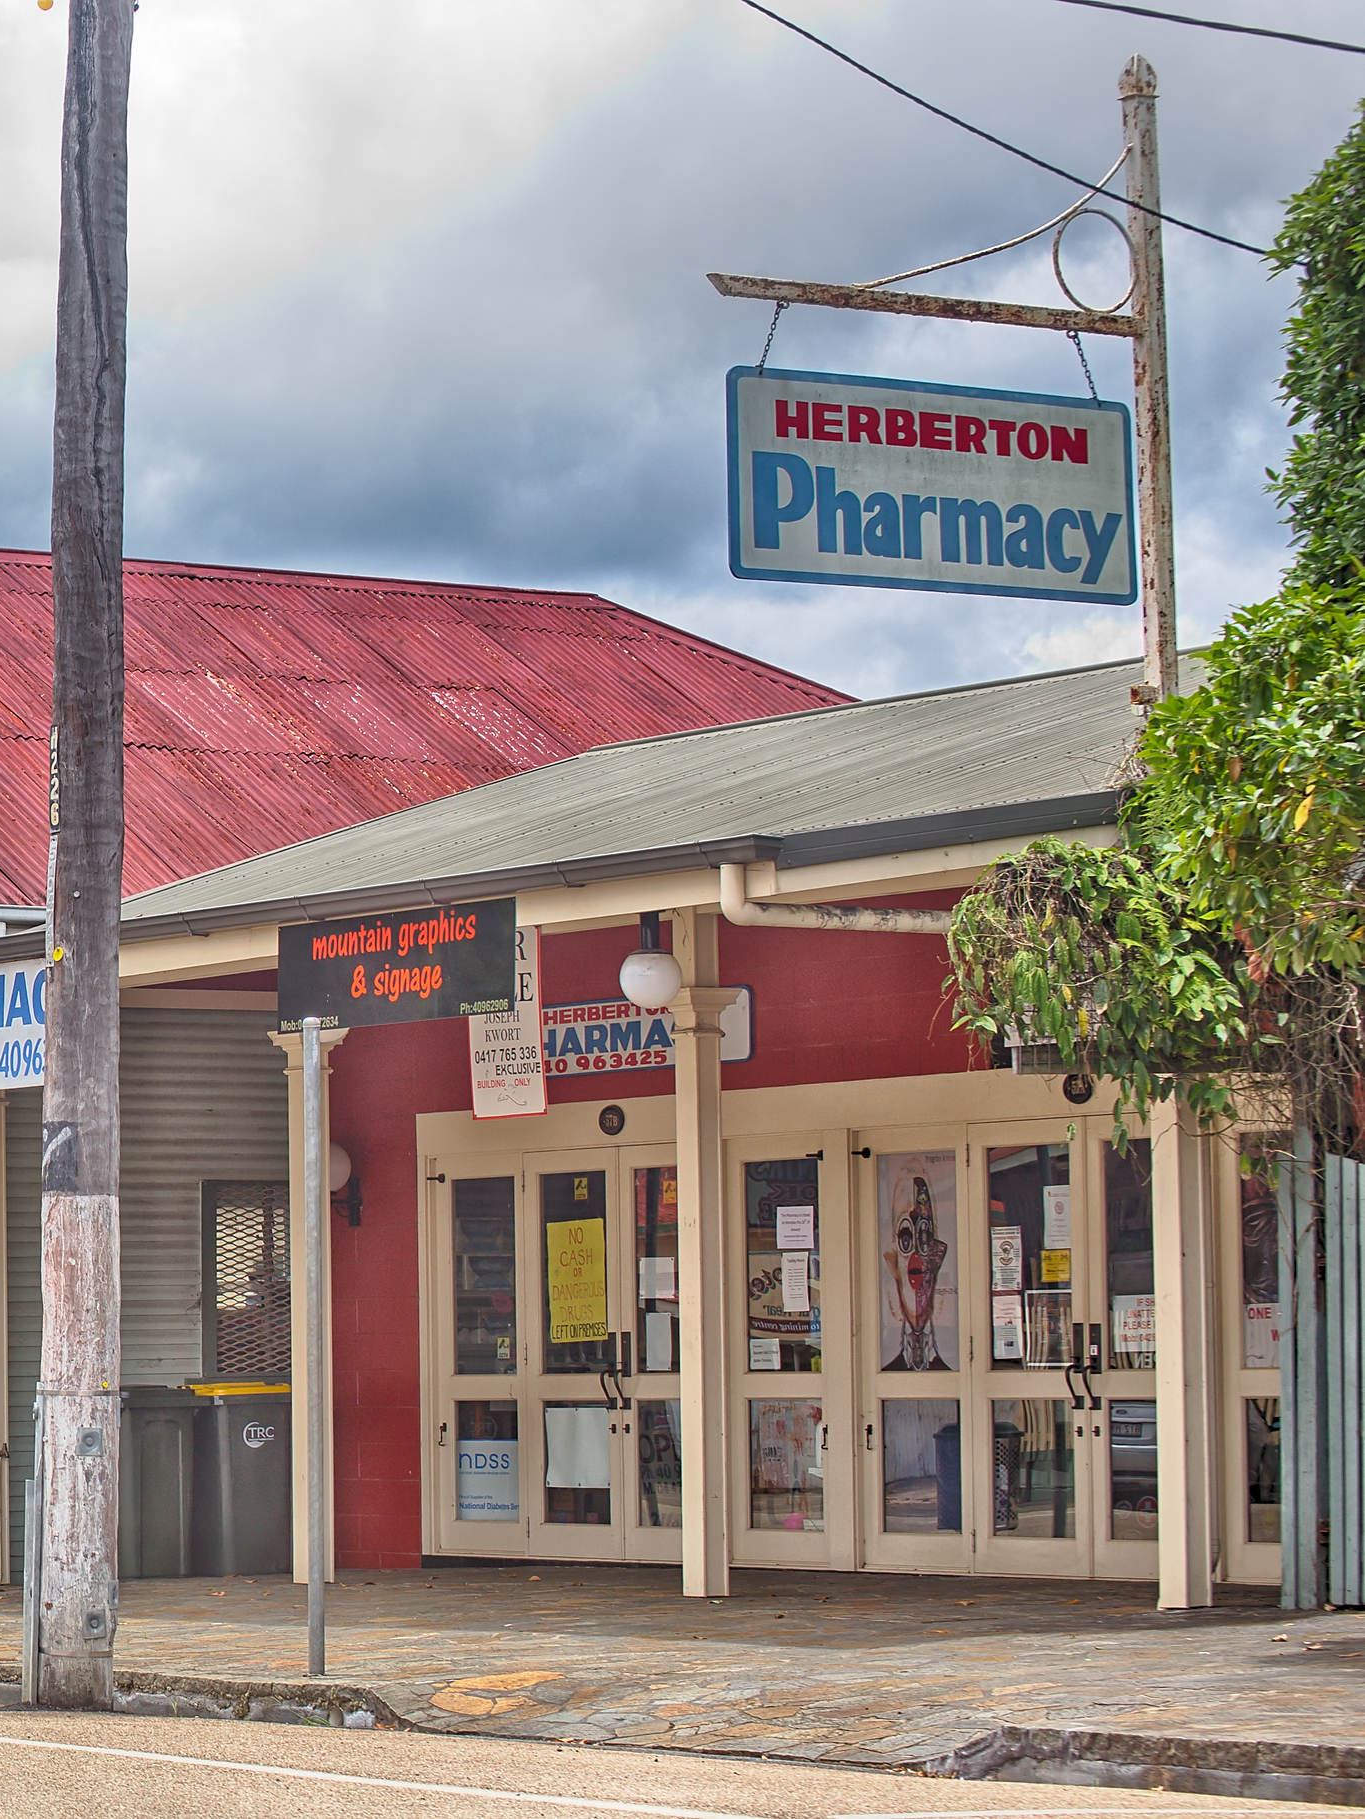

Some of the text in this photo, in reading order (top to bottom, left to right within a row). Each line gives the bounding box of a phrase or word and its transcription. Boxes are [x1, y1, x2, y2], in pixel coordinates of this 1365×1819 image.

[775, 399, 1088, 464] HERBERTON
[752, 450, 1123, 584] Pharmacy
[312, 926, 392, 961] mountain
[398, 911, 477, 957] graphics
[351, 962, 443, 1002] & signage
[460, 999, 509, 1015] Ph:40962906
[484, 1010, 520, 1024] JOSEPH
[484, 1028, 521, 1043] KWORT
[474, 1046, 537, 1064] 0417 765 336
[576, 1050, 667, 1071] 963425
[495, 1062, 541, 1076] EXCLUSIVE
[477, 1077, 531, 1089] BUILDING ONLY
[569, 1227, 584, 1244] NO
[559, 1249, 593, 1267] CASH
[573, 1267, 583, 1277] OR
[552, 1281, 604, 1301] DANGEROUS
[1137, 1297, 1155, 1307] IF SH
[560, 1304, 594, 1323] DRUGS
[1127, 1309, 1155, 1318] UNATTE
[1248, 1307, 1272, 1319] ONE
[552, 1322, 606, 1339] LEFT ON PREMISES
[1123, 1321, 1151, 1330] PLEASE
[248, 1426, 275, 1438] TRC
[459, 1502, 485, 1510] National
[487, 1502, 510, 1510] Diabetes
